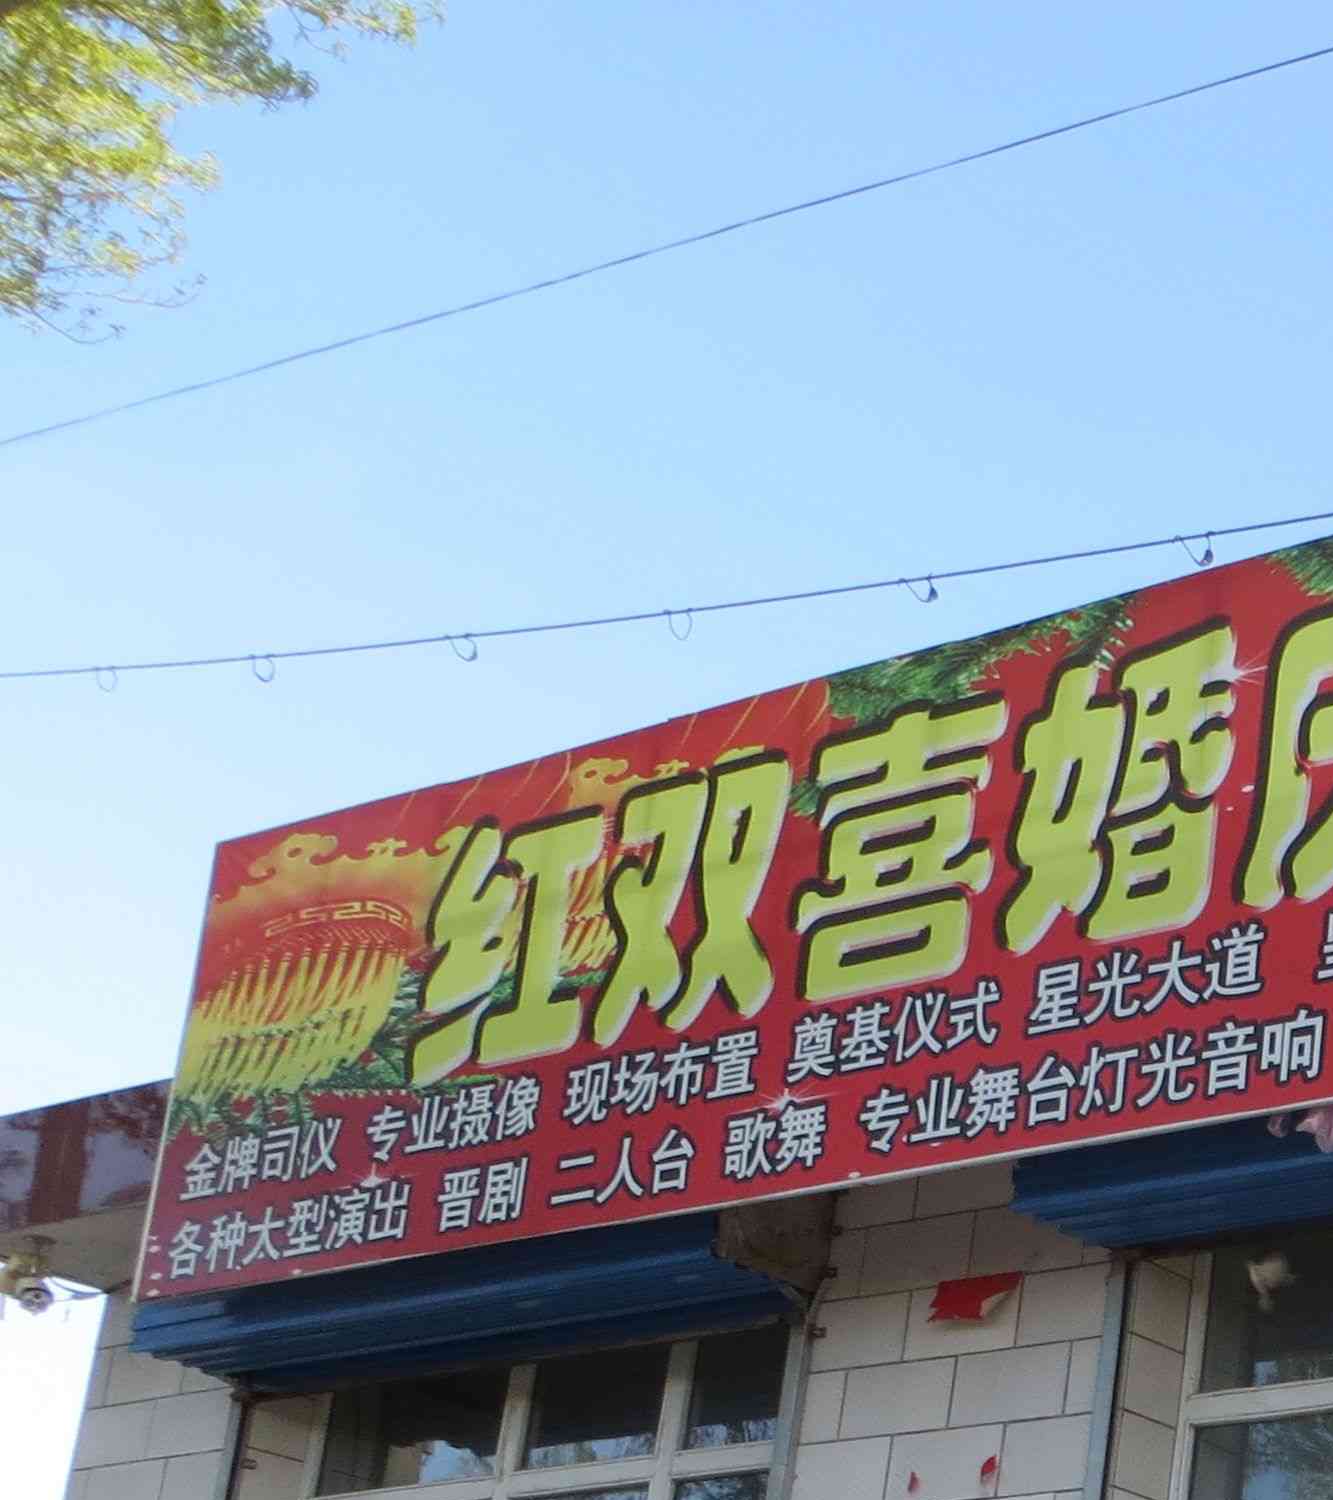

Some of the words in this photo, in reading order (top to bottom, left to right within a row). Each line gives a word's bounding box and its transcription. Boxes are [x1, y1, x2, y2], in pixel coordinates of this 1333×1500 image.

[169, 1179, 409, 1278] 各种大型演出
[439, 1158, 527, 1230] 晋剧
[552, 1130, 693, 1203] 二人台
[725, 1090, 825, 1178] 歌舞
[861, 1010, 1322, 1151] 专业舞台灯光音响
[181, 1113, 341, 1200] 金牌司仪
[368, 1077, 539, 1160] 专业摄像
[564, 1031, 757, 1124] 现场布置
[787, 982, 999, 1082] 奠基仪式
[1028, 924, 1263, 1034] 星光大道
